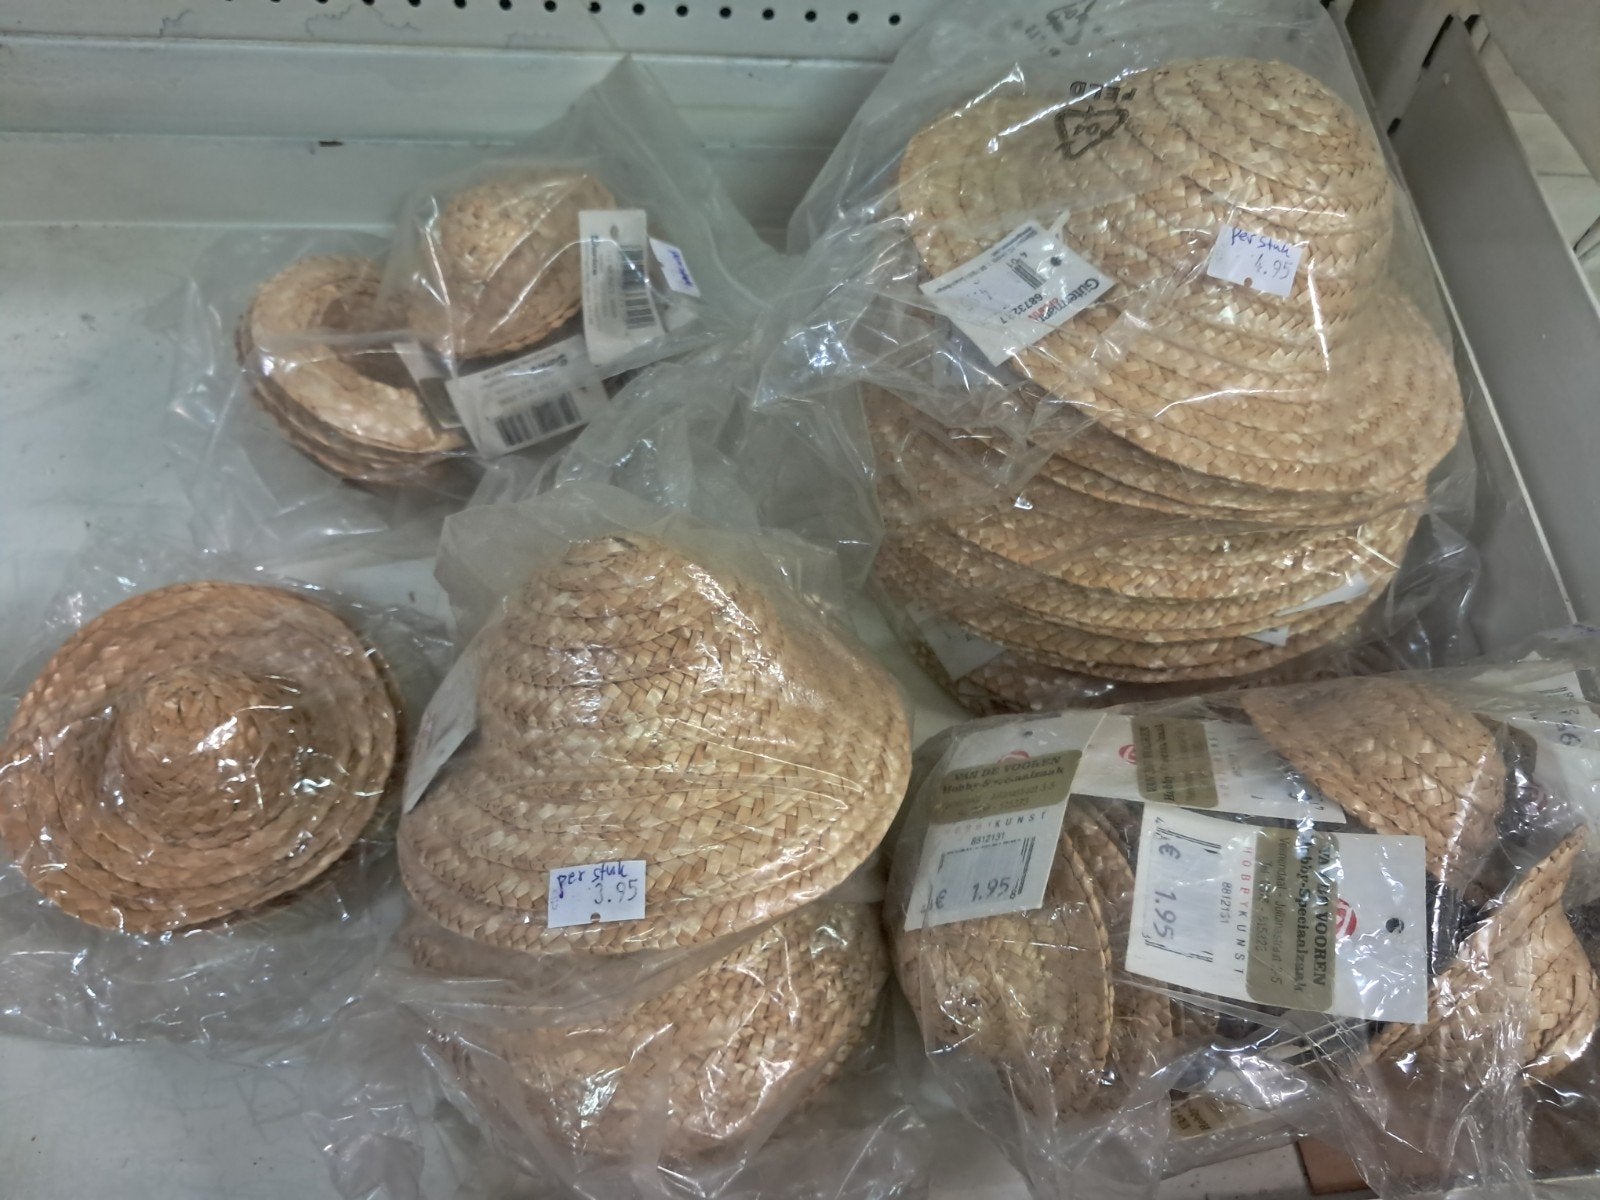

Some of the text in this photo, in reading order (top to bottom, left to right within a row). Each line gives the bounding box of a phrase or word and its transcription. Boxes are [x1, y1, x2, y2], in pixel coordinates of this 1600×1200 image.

[1231, 226, 1256, 246] per
[557, 871, 586, 899] per
[594, 879, 638, 905] 3.95
[972, 876, 1011, 902] 1.95
[1153, 843, 1181, 940] € 1.95
[1313, 912, 1329, 986] VOOREN
